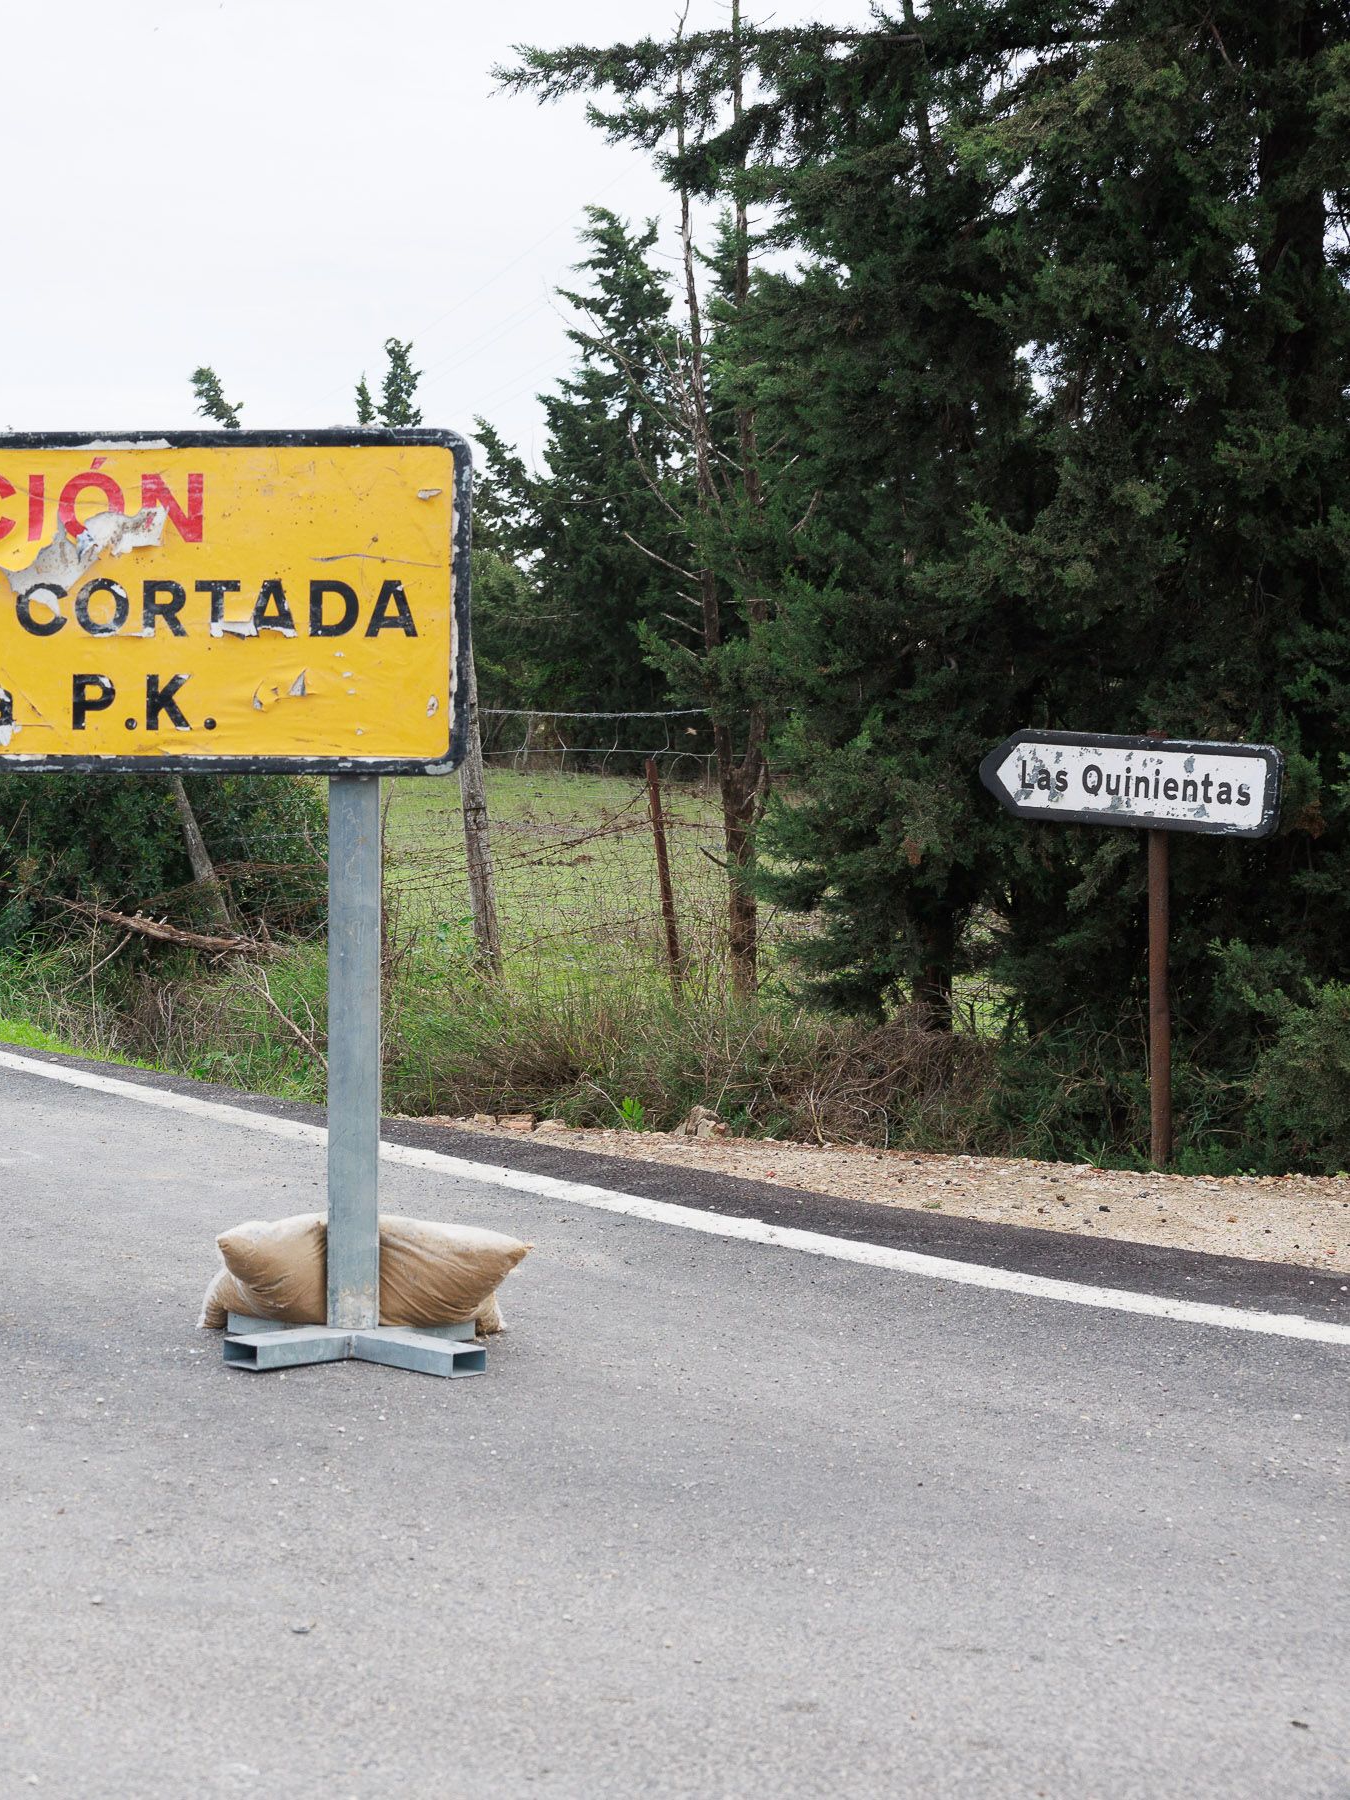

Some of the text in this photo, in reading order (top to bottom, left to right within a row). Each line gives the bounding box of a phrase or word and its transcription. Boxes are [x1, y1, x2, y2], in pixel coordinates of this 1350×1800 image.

[15, 578, 419, 638] CORTADA
[72, 673, 218, 731] P.K.
[1020, 759, 1252, 806] Las Quinientas
